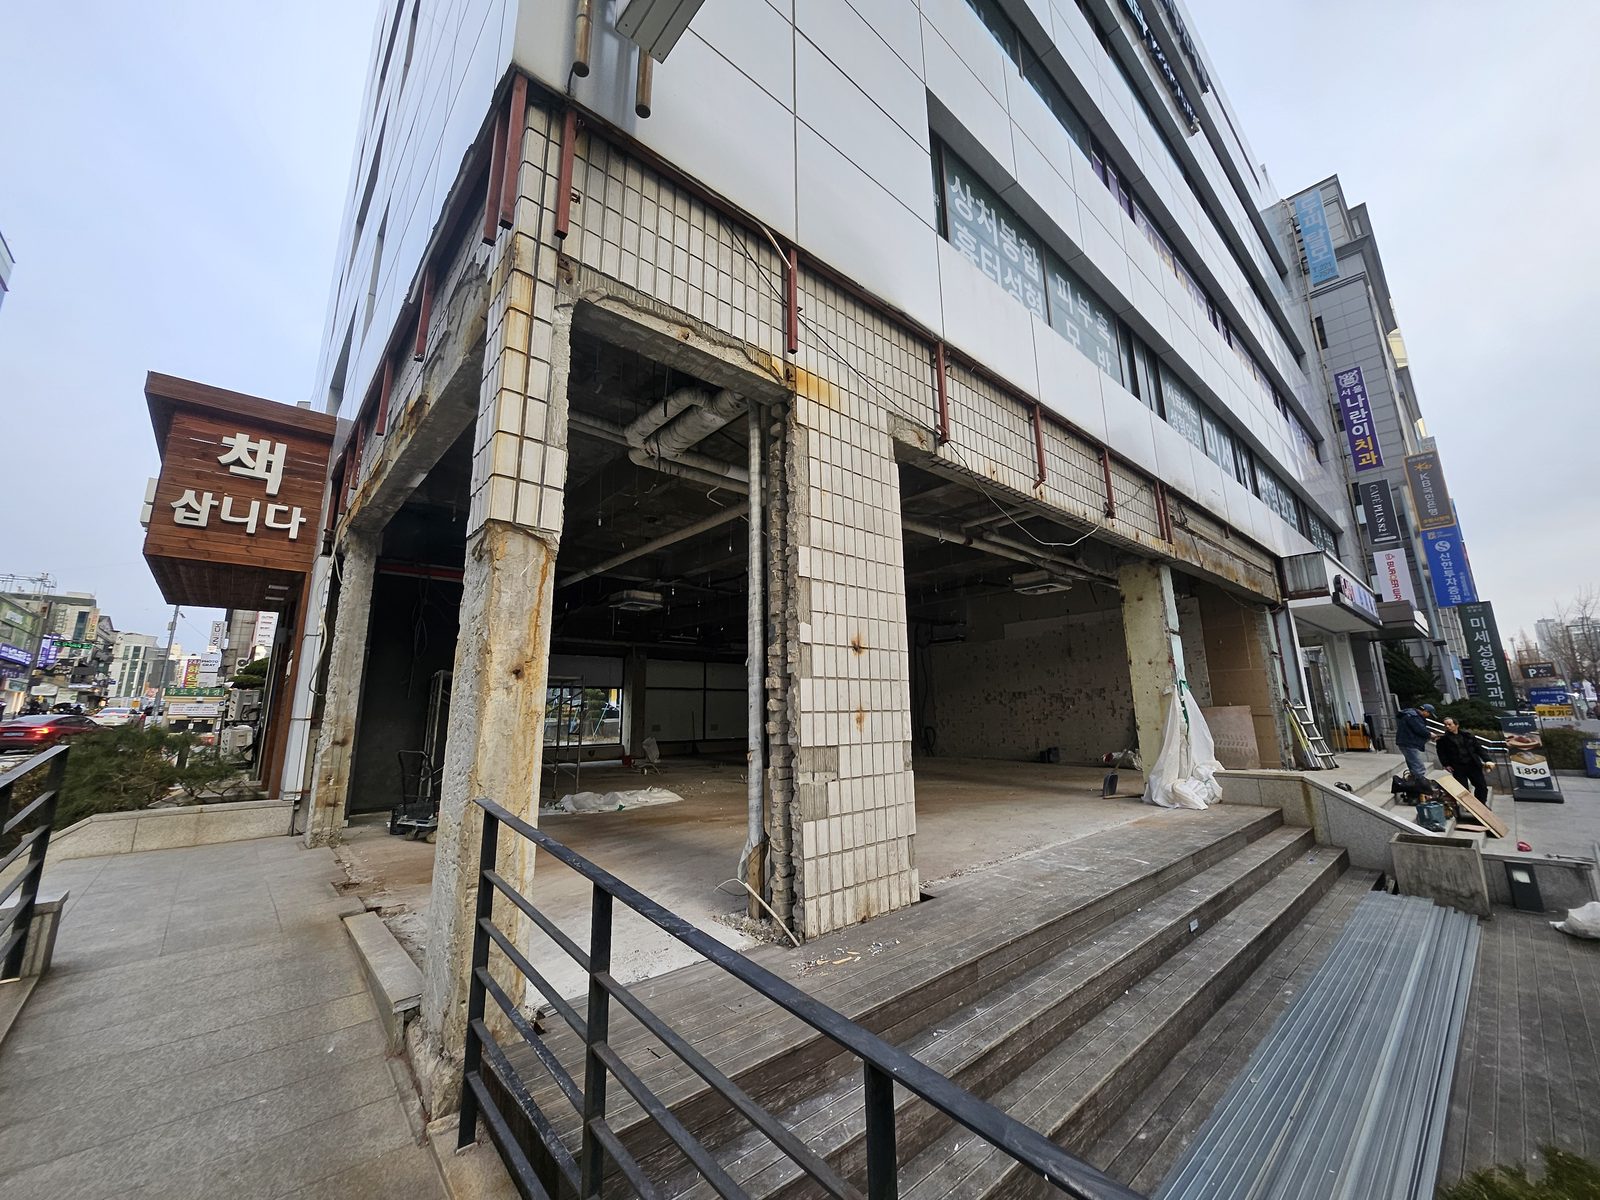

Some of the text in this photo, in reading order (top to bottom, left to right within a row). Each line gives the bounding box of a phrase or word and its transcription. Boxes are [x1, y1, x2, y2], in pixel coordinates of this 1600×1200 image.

[950, 175, 1039, 283] 상처봉합
[217, 432, 287, 496] 책
[170, 490, 306, 540] 삽니다
[1439, 553, 1462, 604] 신한투자증권
[1470, 616, 1505, 700] 미세성형외과
